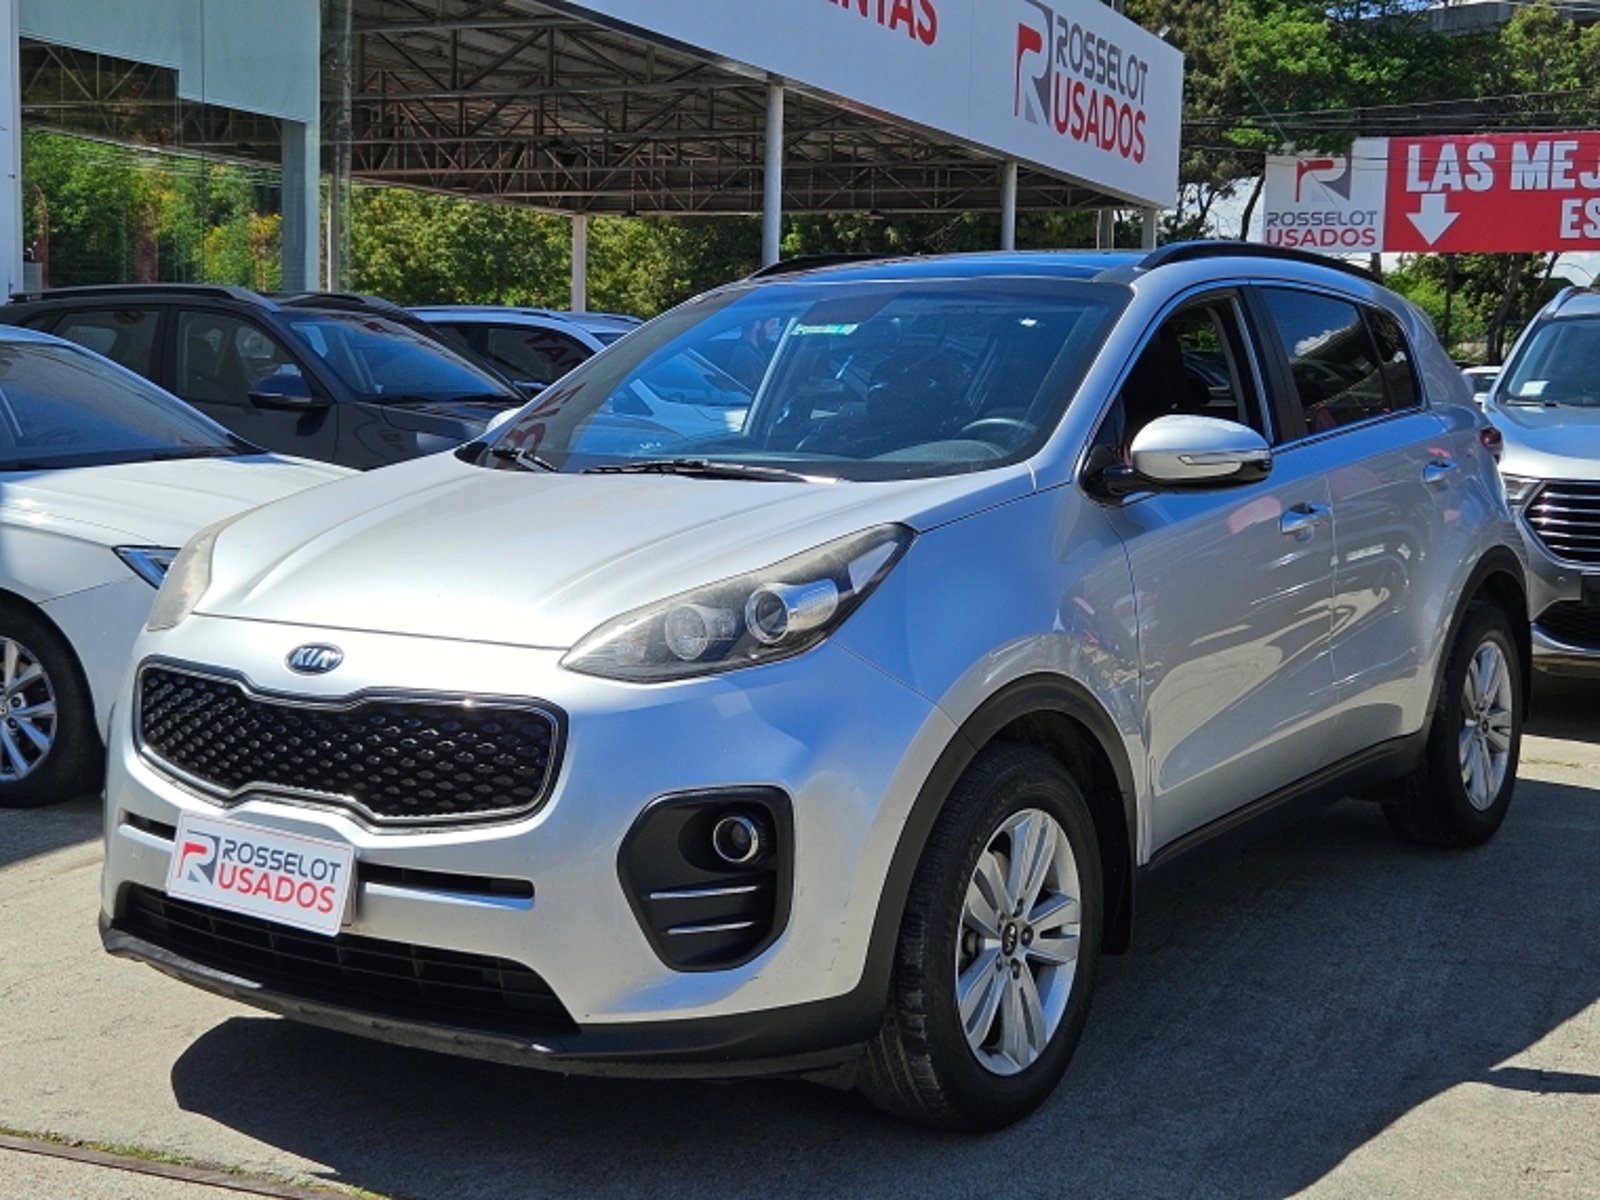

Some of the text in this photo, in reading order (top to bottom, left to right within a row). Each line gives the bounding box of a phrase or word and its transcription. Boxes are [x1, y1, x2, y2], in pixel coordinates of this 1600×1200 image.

[1055, 15, 1148, 106] ROSSELOT
[1053, 71, 1147, 164] USADOS
[1406, 142, 1496, 192] LAS
[1265, 227, 1377, 248] USADOS
[1266, 210, 1378, 228] ROSSELOT
[291, 647, 341, 669] KIA
[222, 838, 342, 884] ROSSELOT
[218, 863, 335, 914] USADOS
